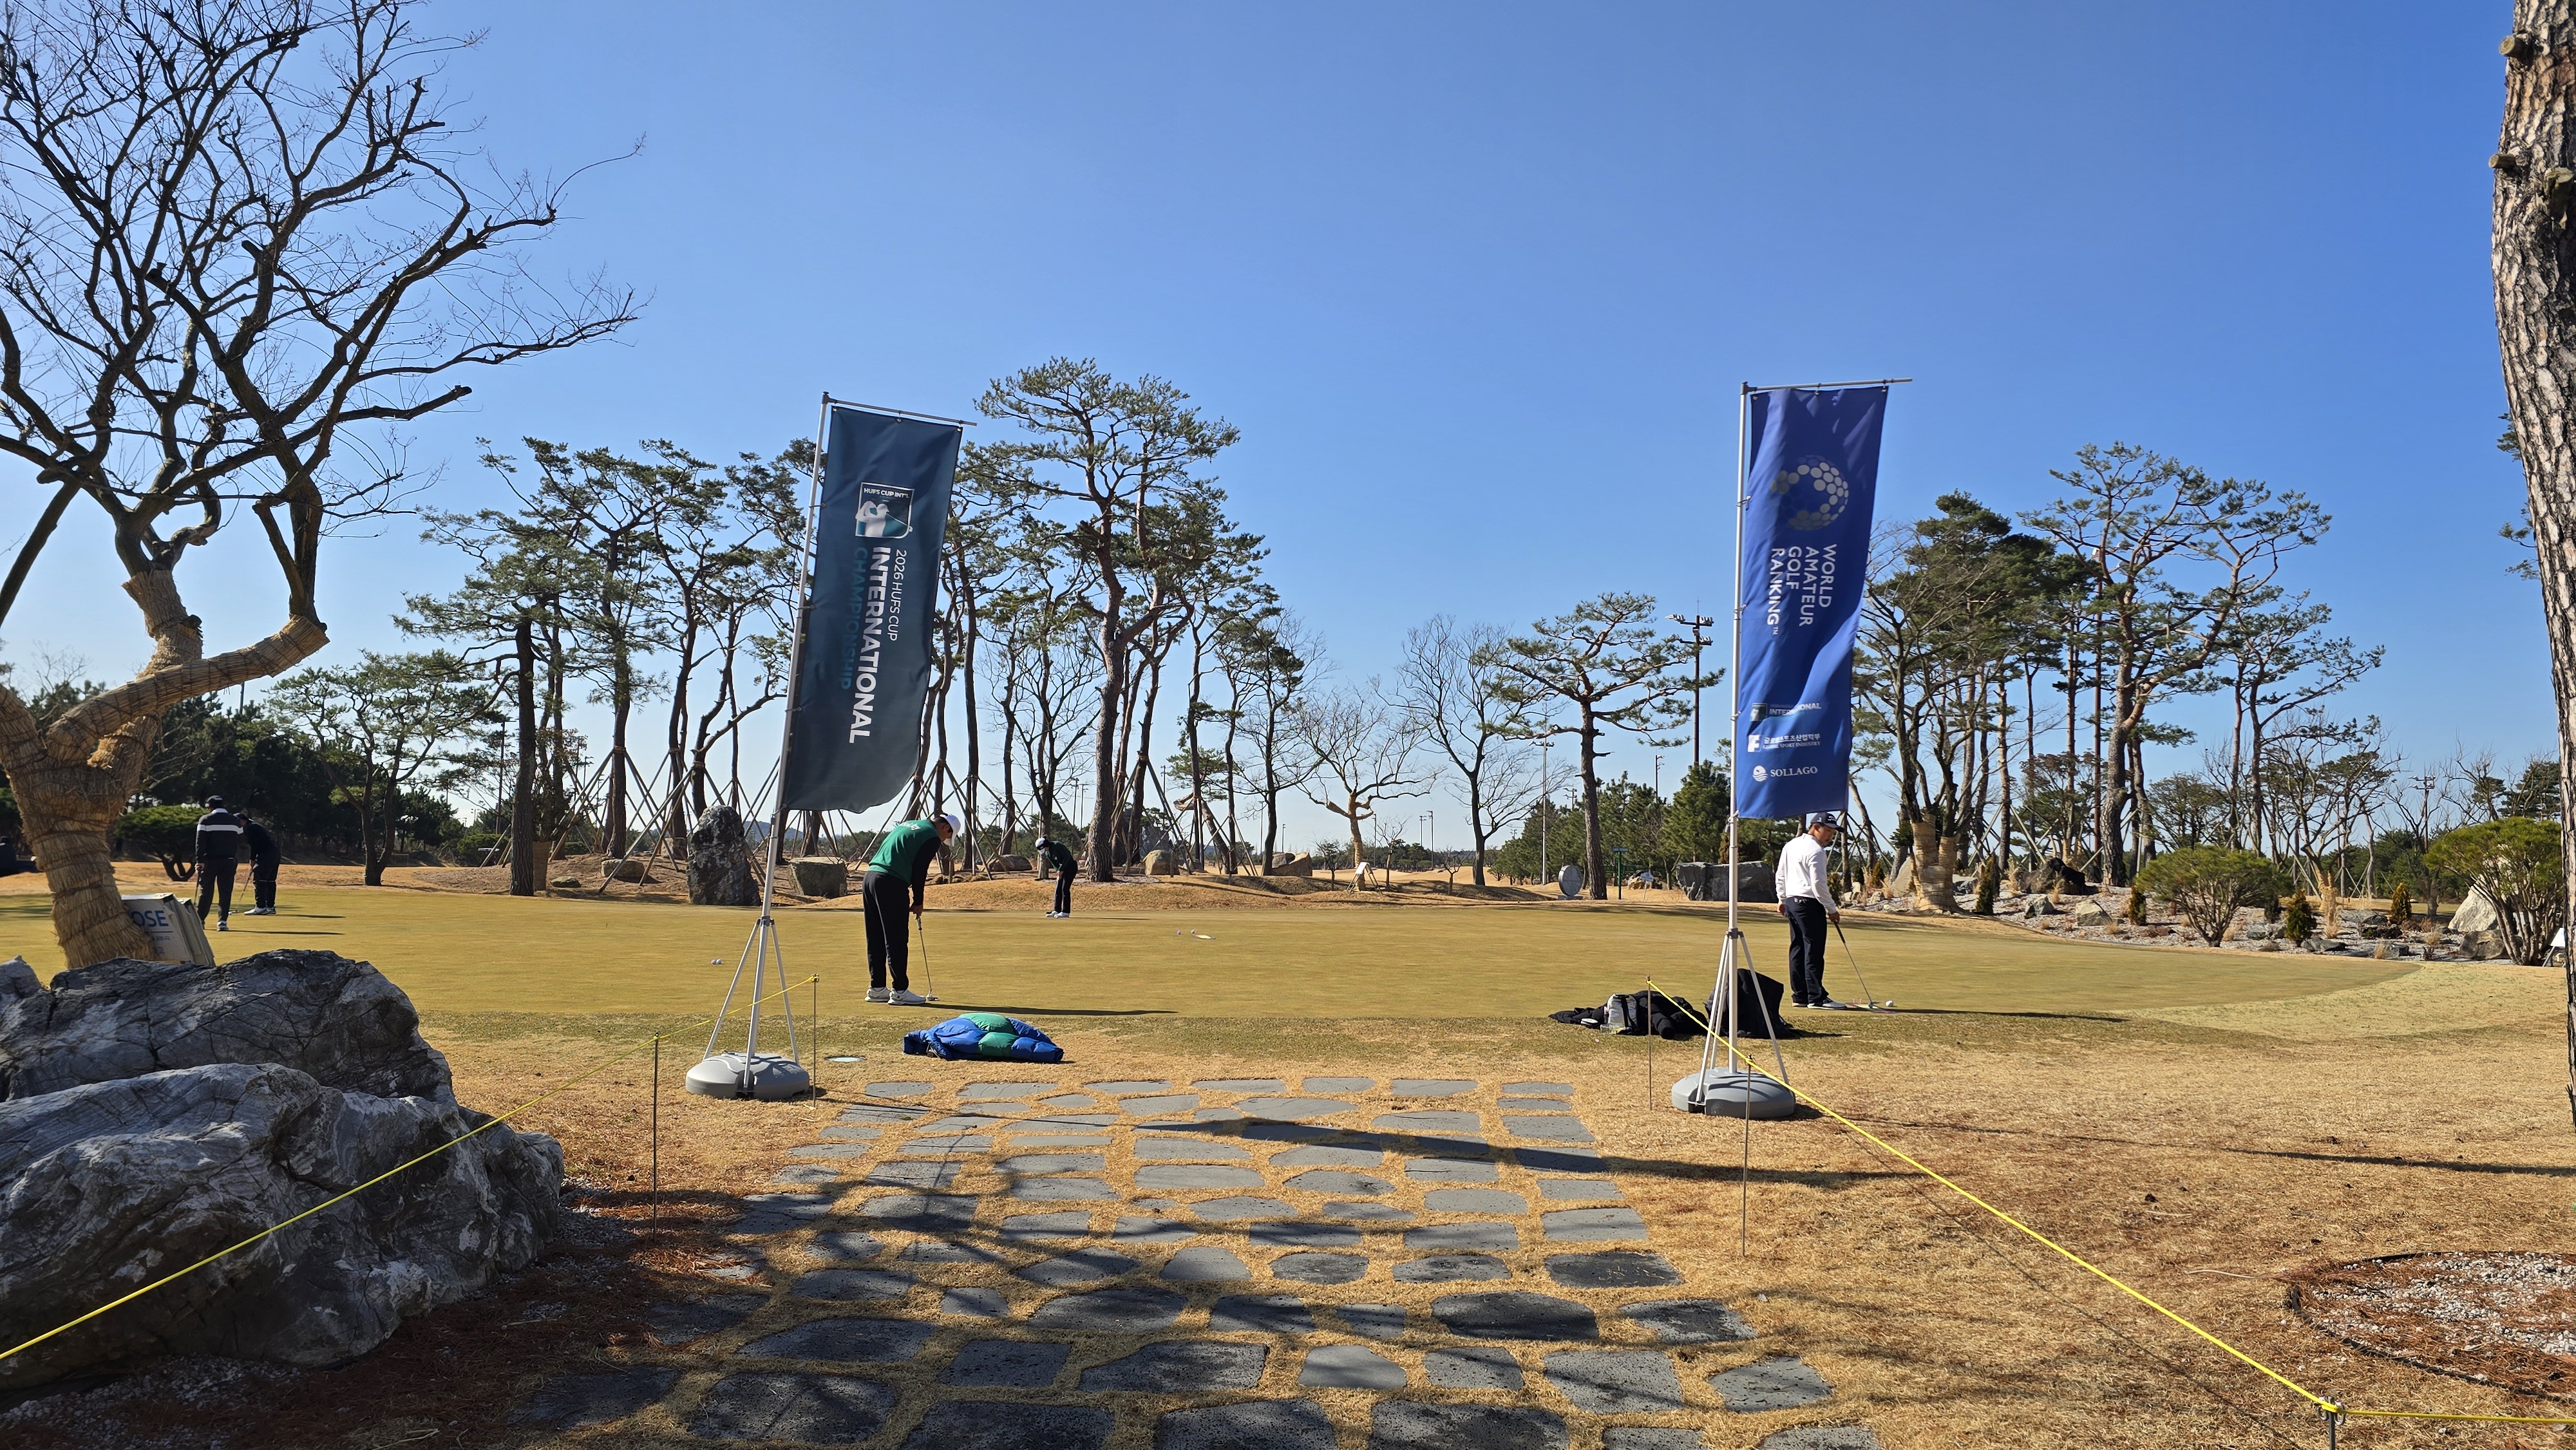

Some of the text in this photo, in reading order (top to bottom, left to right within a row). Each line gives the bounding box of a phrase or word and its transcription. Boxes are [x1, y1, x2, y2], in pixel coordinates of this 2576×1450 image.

[887, 549, 907, 641] 2026 HUFS CUP
[1786, 546, 1802, 589] GOLF
[1799, 547, 1819, 626] AMATEUR
[1819, 544, 1837, 607] WORLD
[840, 547, 868, 690] CHAMPIONSHIP
[849, 547, 891, 744] INTERNATIONAL
[1769, 702, 1822, 715] INTEONAL
[1770, 766, 1819, 777] SOLLAGO
[131, 910, 169, 927] OSE
